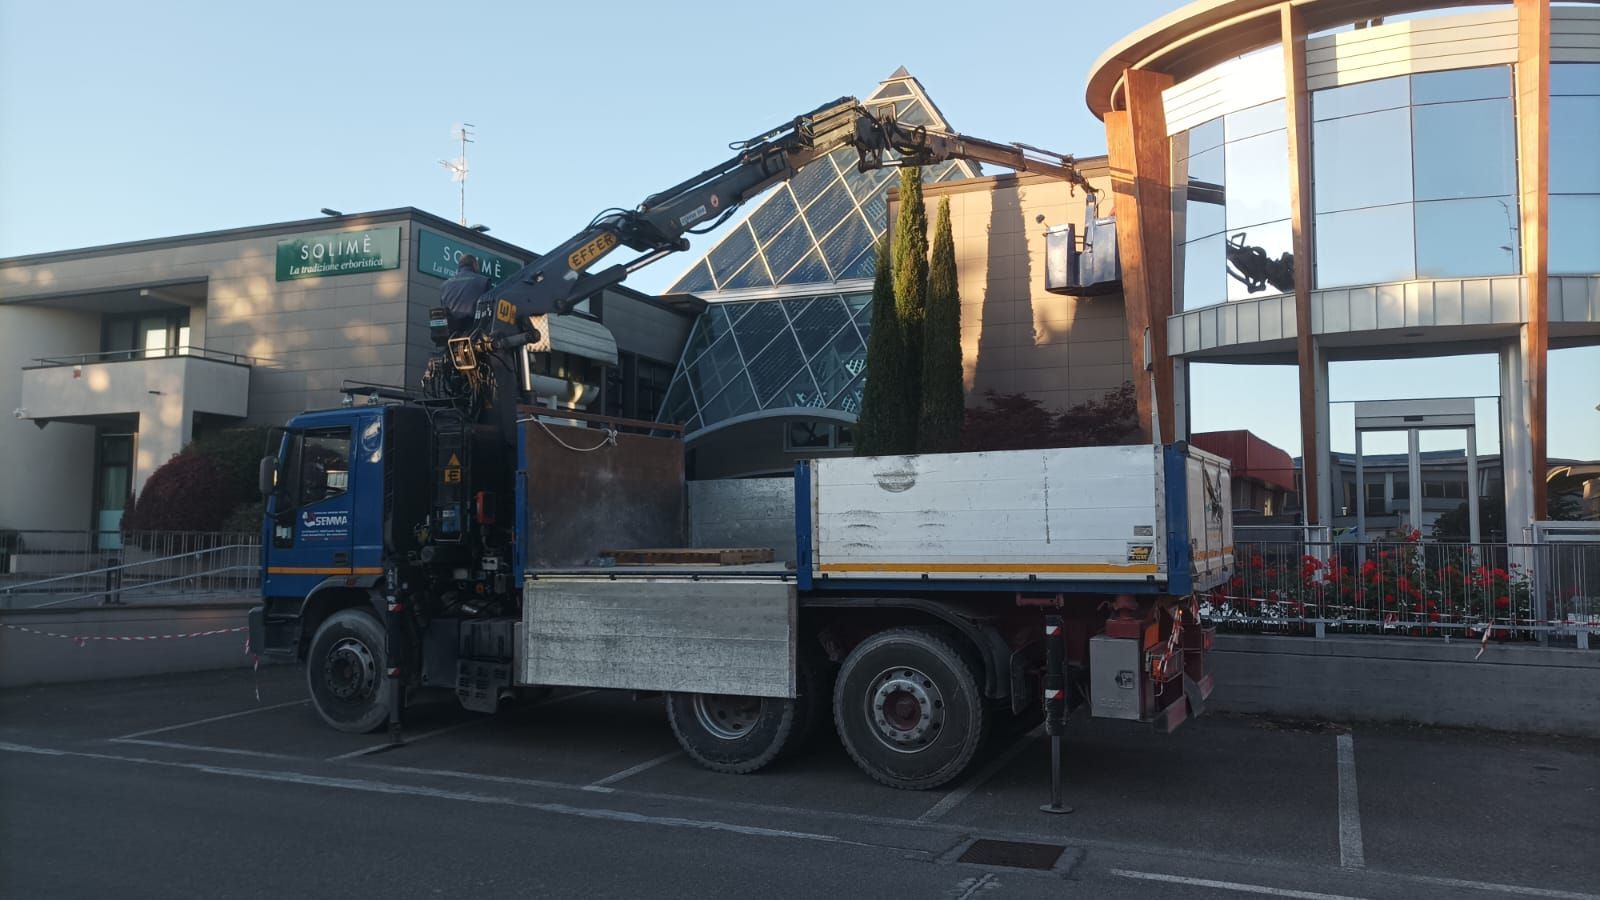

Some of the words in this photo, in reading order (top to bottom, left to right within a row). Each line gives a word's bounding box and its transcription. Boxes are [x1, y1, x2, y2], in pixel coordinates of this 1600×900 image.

[300, 233, 372, 261] SOLIMÈ
[572, 233, 616, 267] EFFER
[289, 265, 300, 275] La
[301, 261, 340, 274] tradizione
[340, 257, 383, 271] erboristica
[443, 246, 502, 279] SOMÈ
[315, 516, 348, 526] SEMMA
